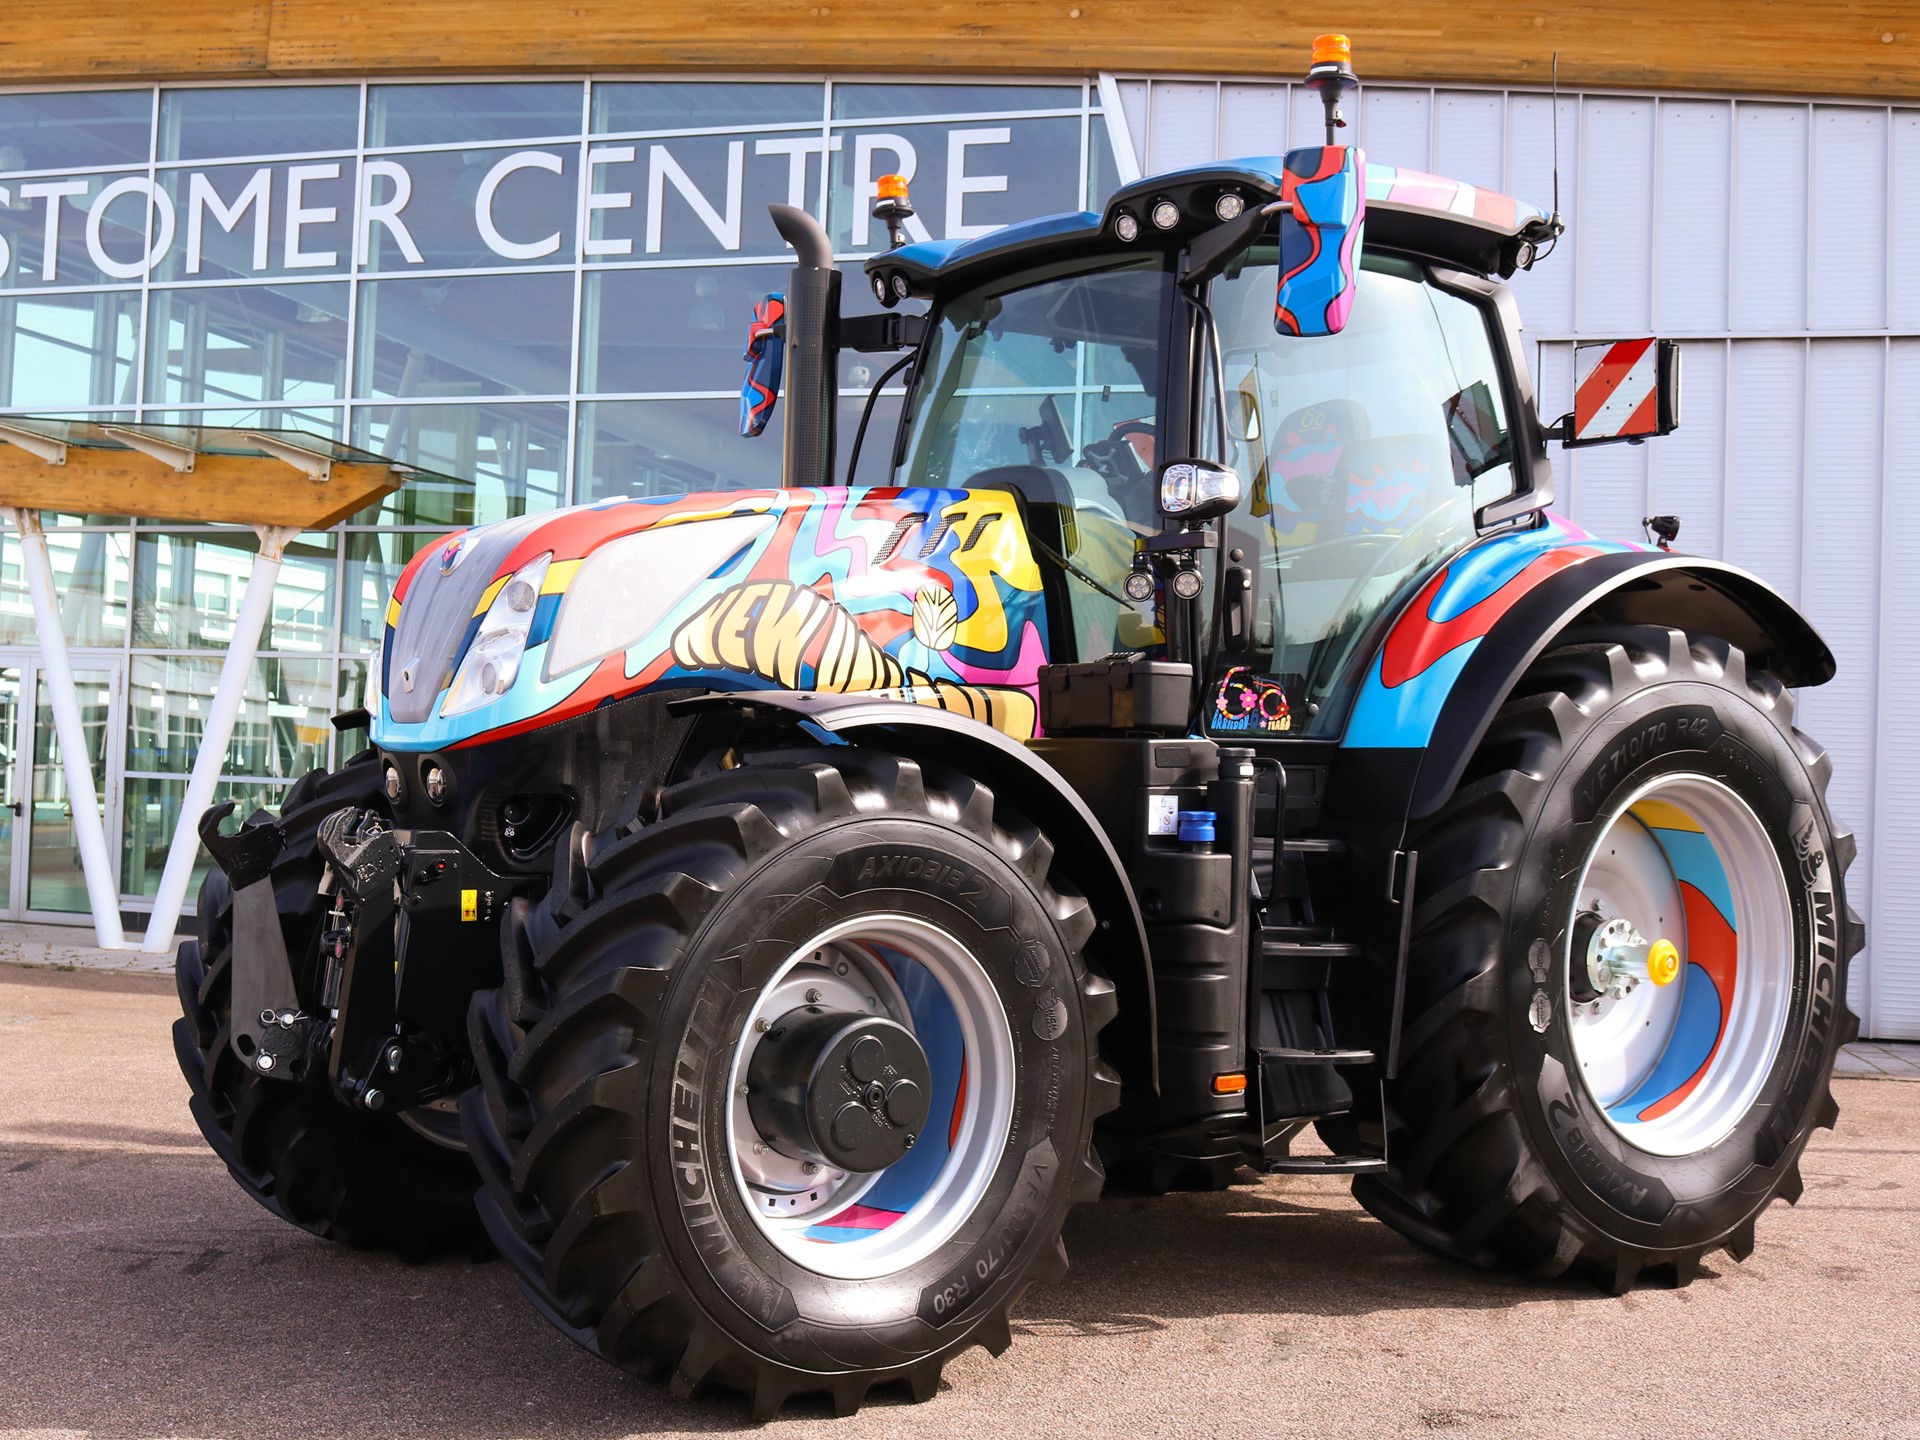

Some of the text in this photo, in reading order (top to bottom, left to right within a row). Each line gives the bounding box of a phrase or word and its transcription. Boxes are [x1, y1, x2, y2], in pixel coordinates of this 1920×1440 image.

[0, 127, 1010, 281] TOMER CENTRE
[670, 578, 835, 691] NEW
[1610, 722, 1668, 774] 710/70
[1675, 717, 1709, 739] R42
[857, 855, 966, 888] AXIOBIB
[673, 974, 737, 1266] MICHELIN
[933, 1275, 970, 1314] R30
